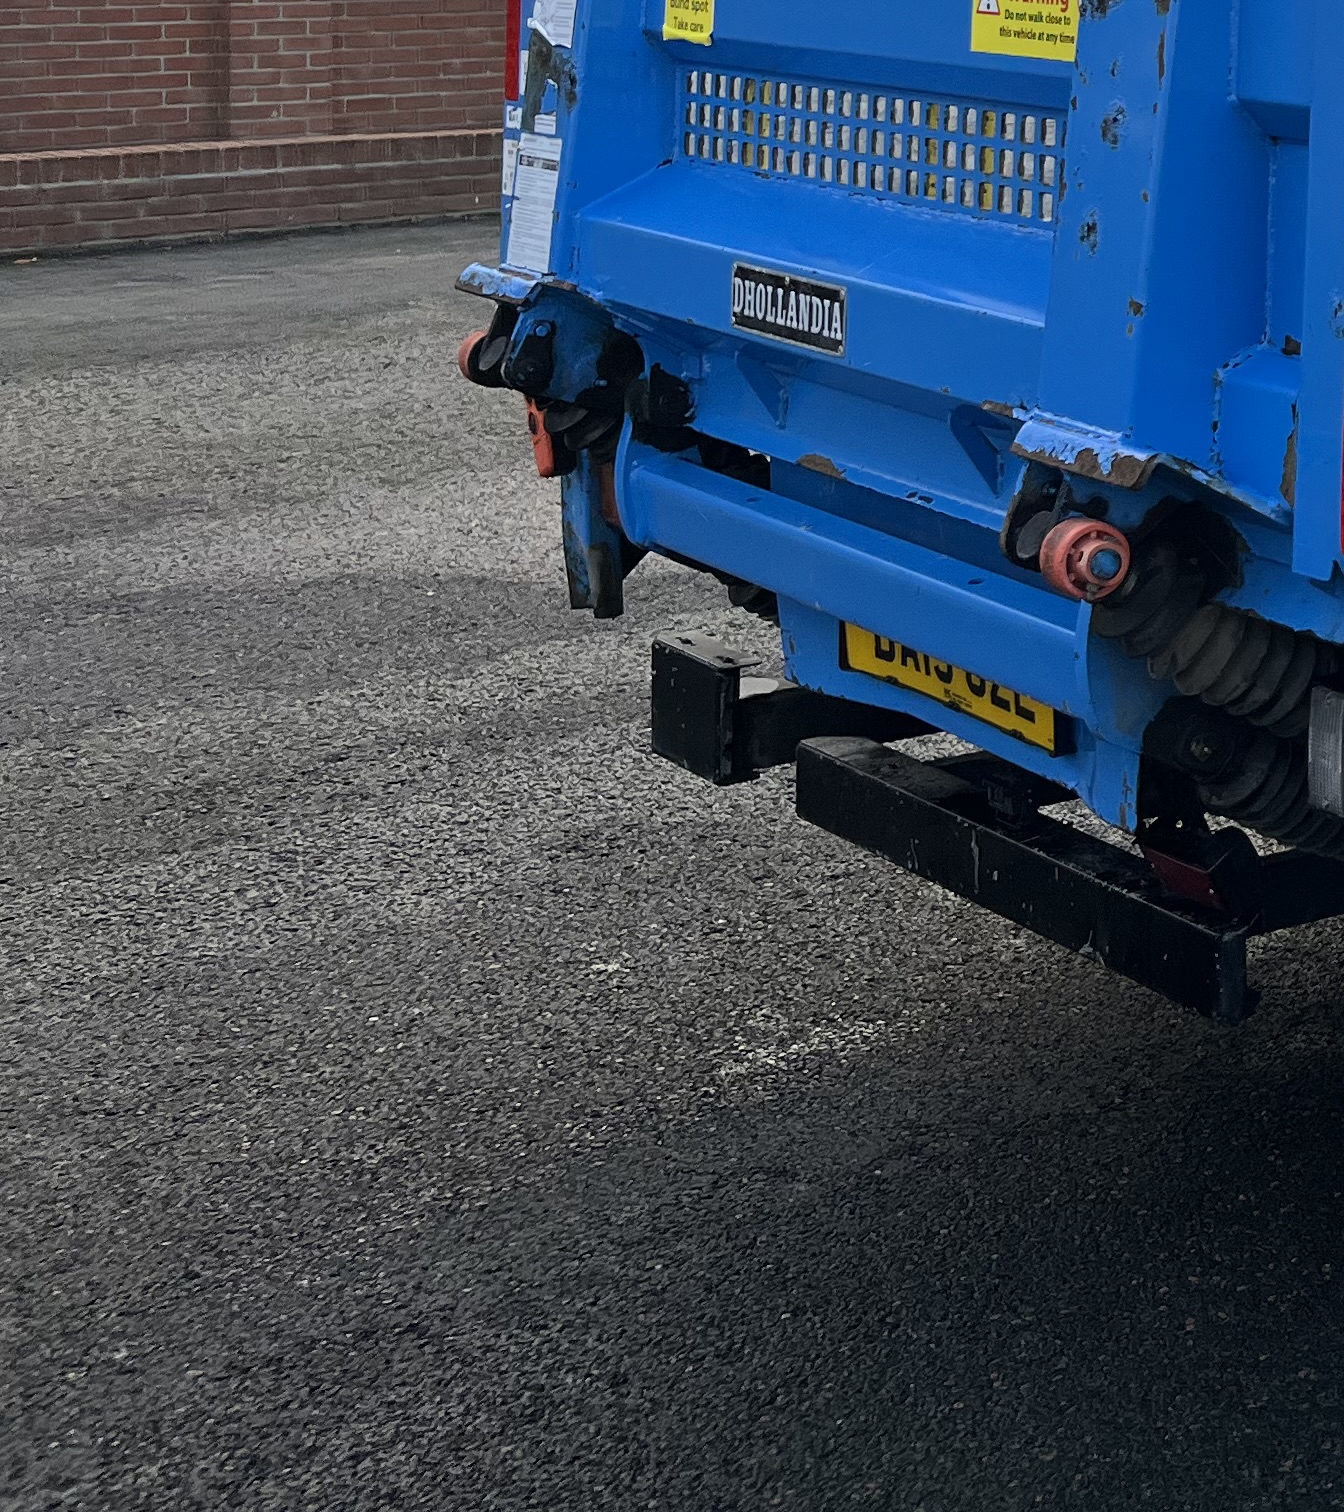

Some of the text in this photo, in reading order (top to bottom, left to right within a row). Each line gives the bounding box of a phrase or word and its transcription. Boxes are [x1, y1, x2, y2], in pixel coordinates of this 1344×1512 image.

[691, 0, 709, 16] spot
[673, 16, 704, 33] Take care
[1004, 9, 1071, 26] Do not walk close to
[999, 26, 1075, 45] this vehicle at any time
[733, 277, 843, 341] DHOLLANDIA
